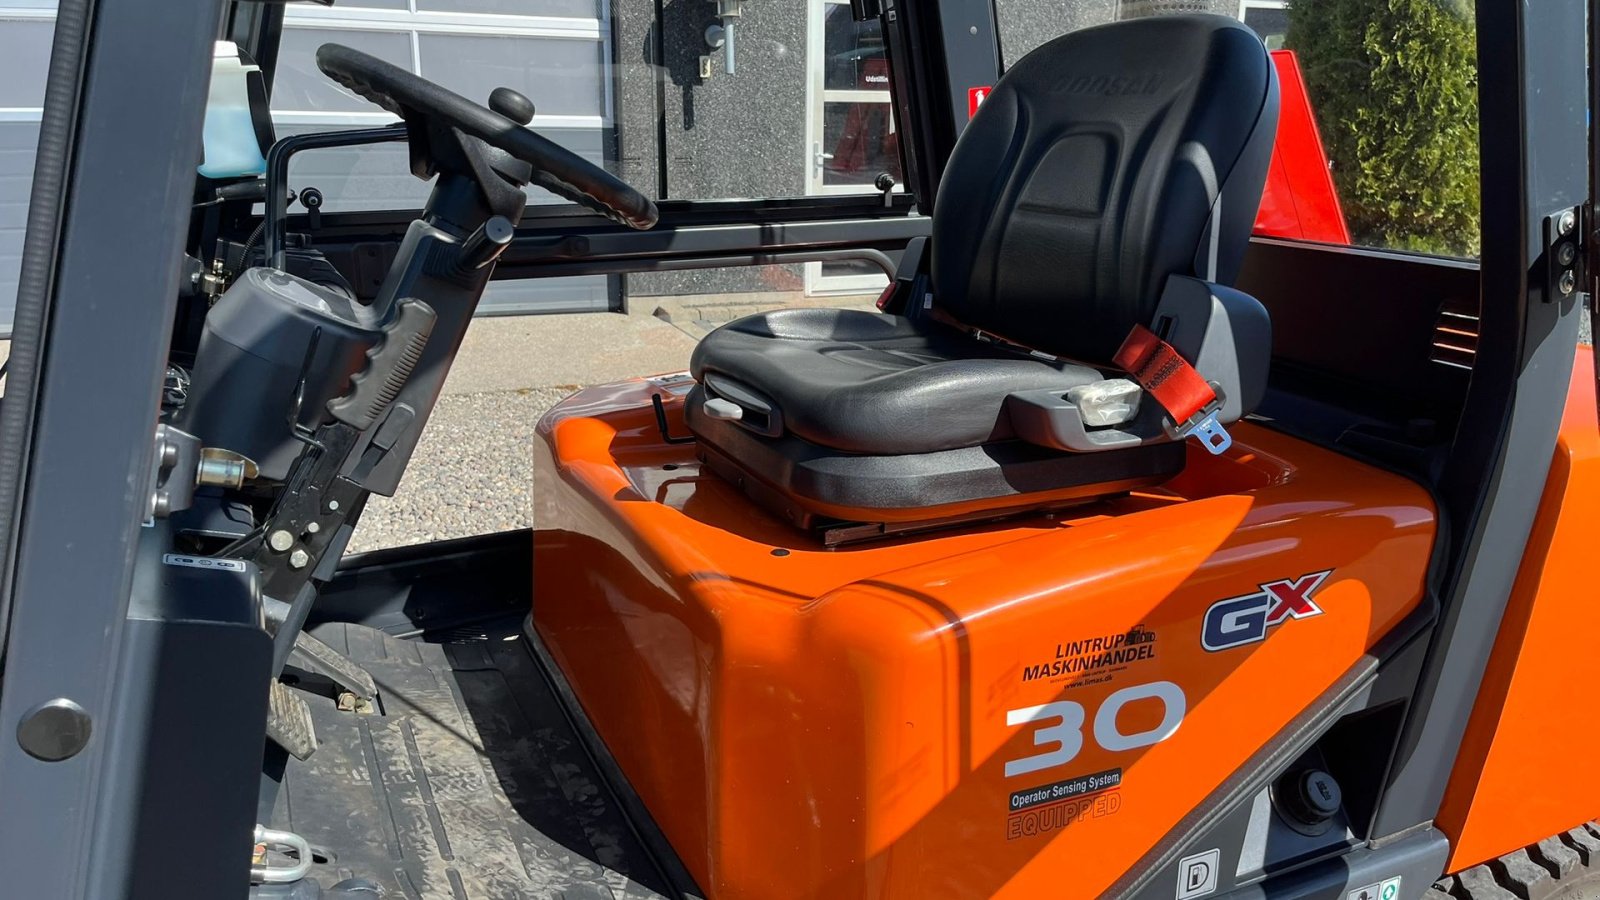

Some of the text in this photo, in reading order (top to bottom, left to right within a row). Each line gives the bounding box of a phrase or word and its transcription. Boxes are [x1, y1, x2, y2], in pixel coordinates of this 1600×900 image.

[1200, 568, 1335, 653] GX
[1022, 644, 1155, 681] MASKINHANDEL
[1056, 634, 1126, 658] LINTRUP
[1063, 674, 1113, 690] www.limas.dk
[1004, 681, 1186, 777] 30
[1012, 773, 1119, 807] Operator Sensing System
[1007, 792, 1121, 840] EQUIPPED
